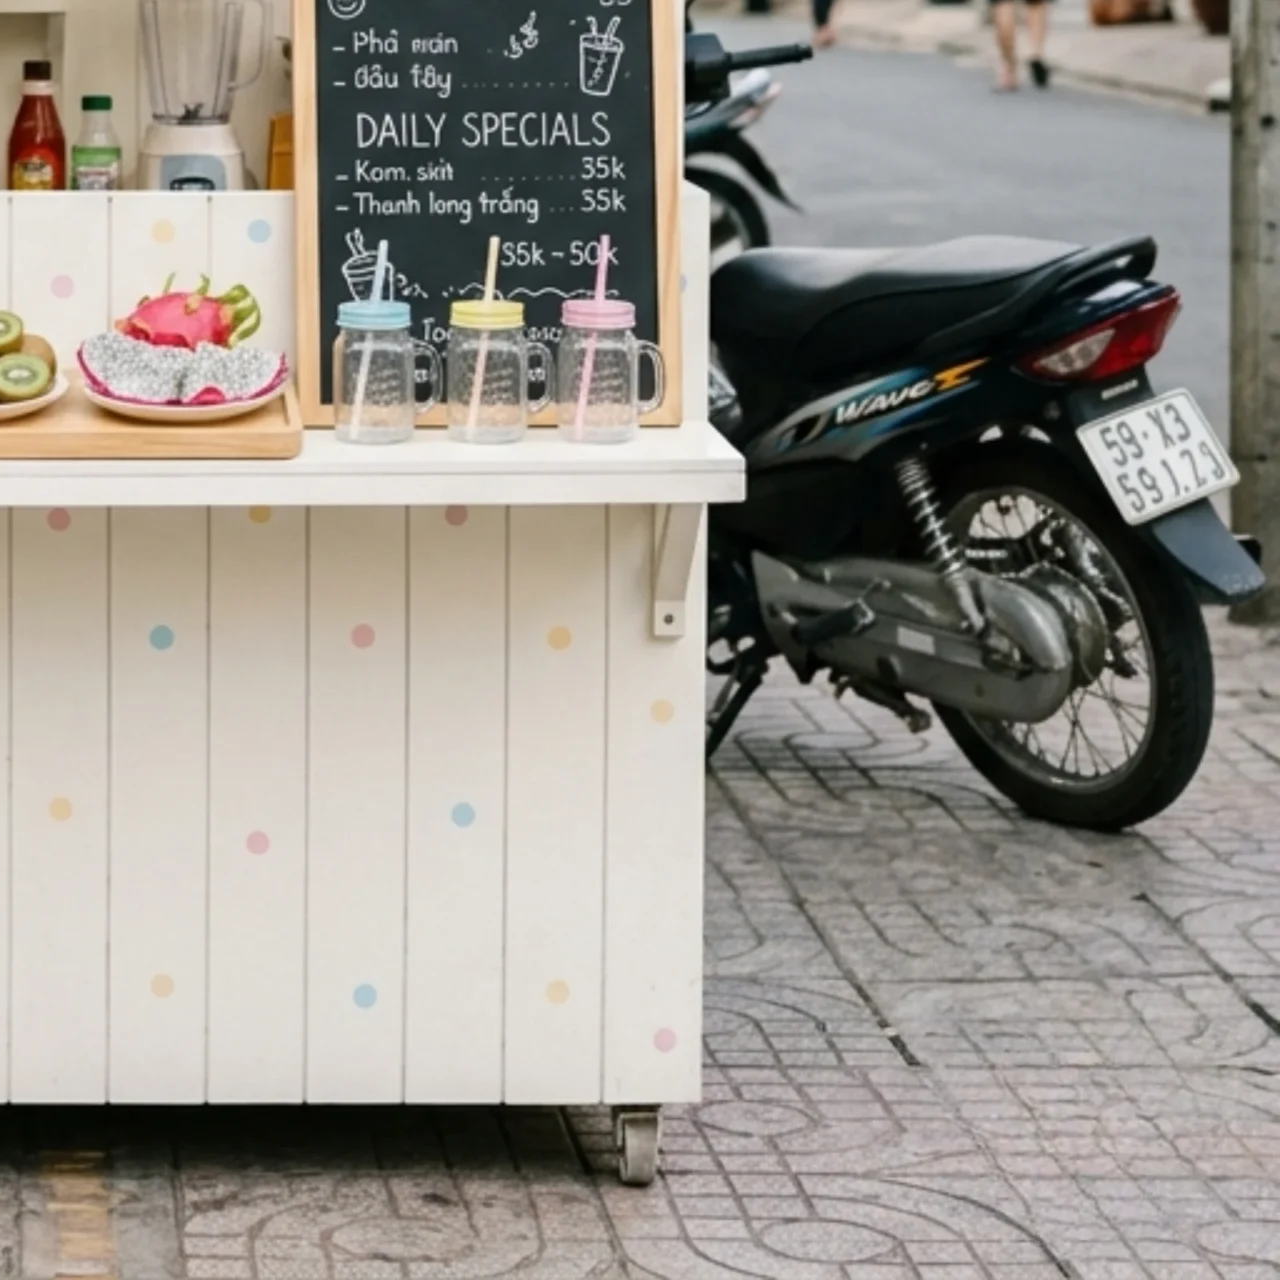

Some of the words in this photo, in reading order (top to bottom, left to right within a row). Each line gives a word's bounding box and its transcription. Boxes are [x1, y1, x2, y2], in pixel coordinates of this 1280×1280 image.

[357, 113, 446, 149] DAILY
[462, 111, 611, 149] SPECIALS
[581, 155, 626, 180] 35k
[352, 191, 421, 215] Thanh
[428, 190, 472, 224] long
